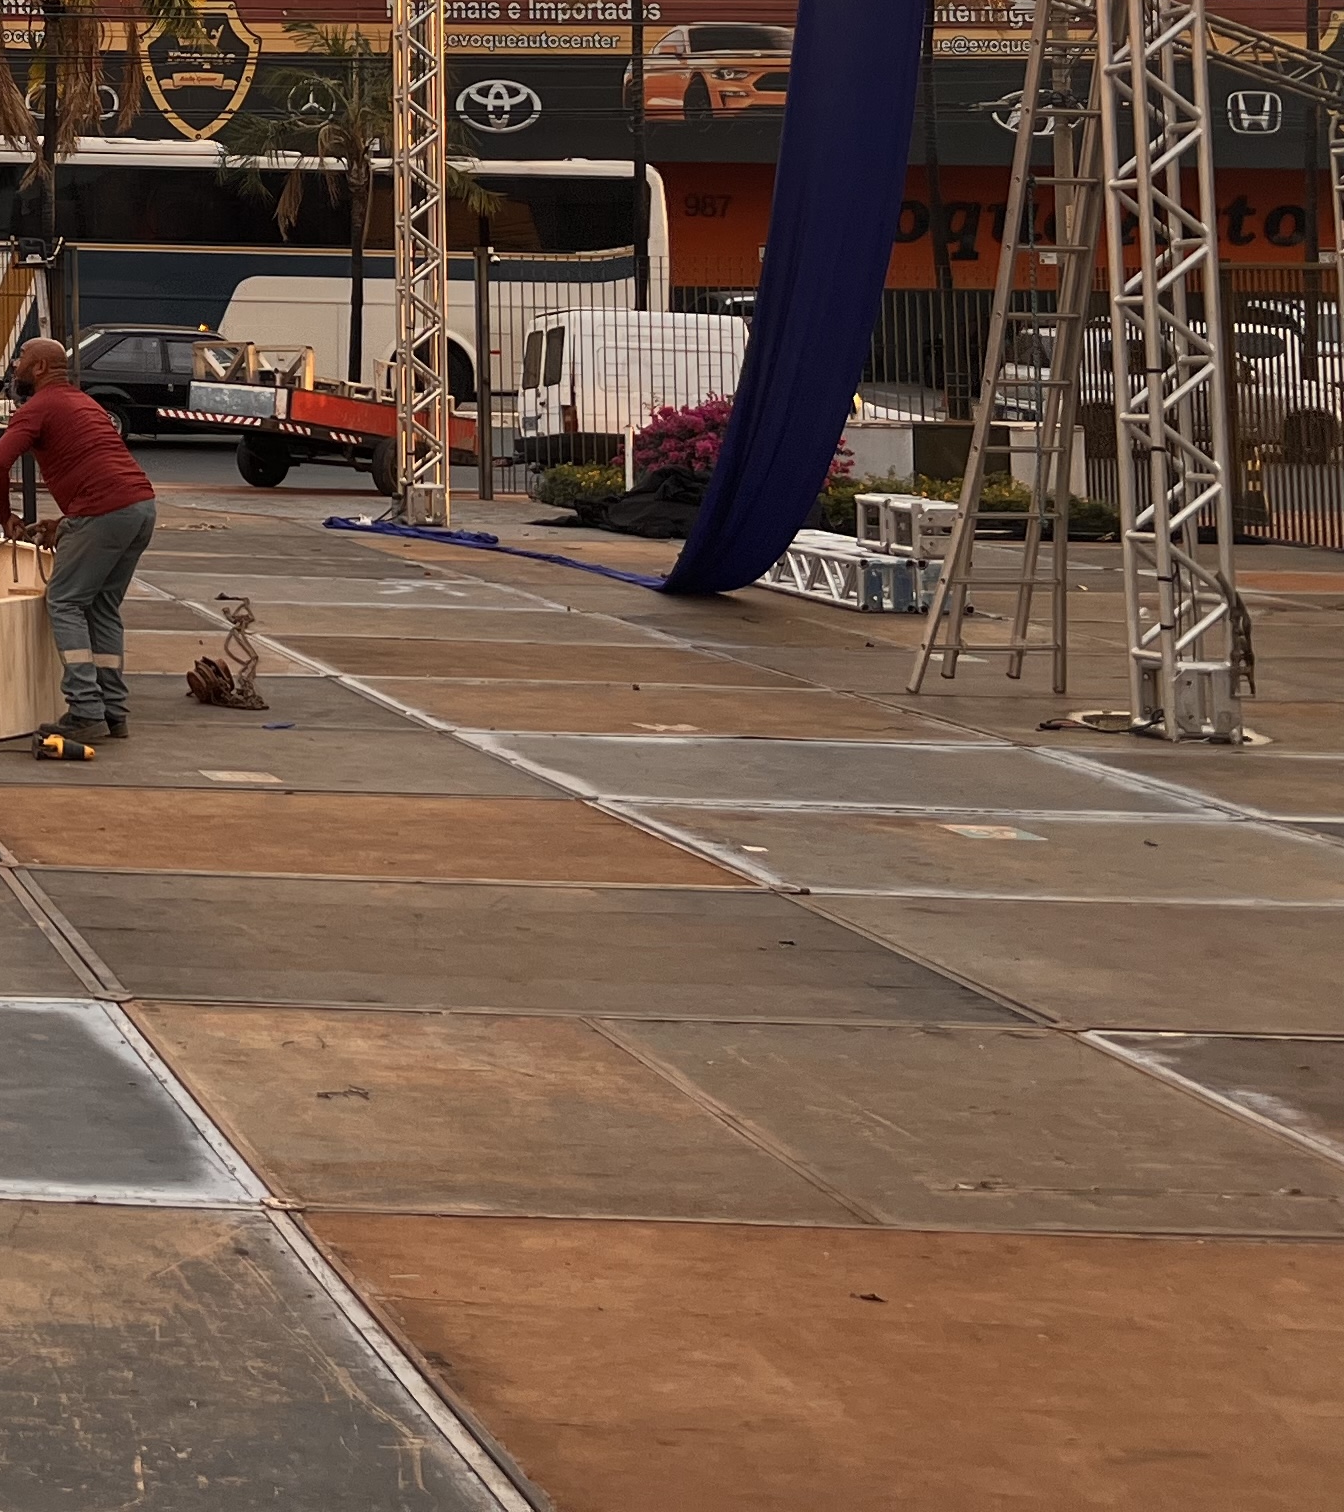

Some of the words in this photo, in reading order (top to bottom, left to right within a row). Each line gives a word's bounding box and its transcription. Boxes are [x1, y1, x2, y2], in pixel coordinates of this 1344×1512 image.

[508, 2, 521, 19] e
[443, 32, 620, 51] evoqueautocenter
[684, 193, 732, 218] 987
